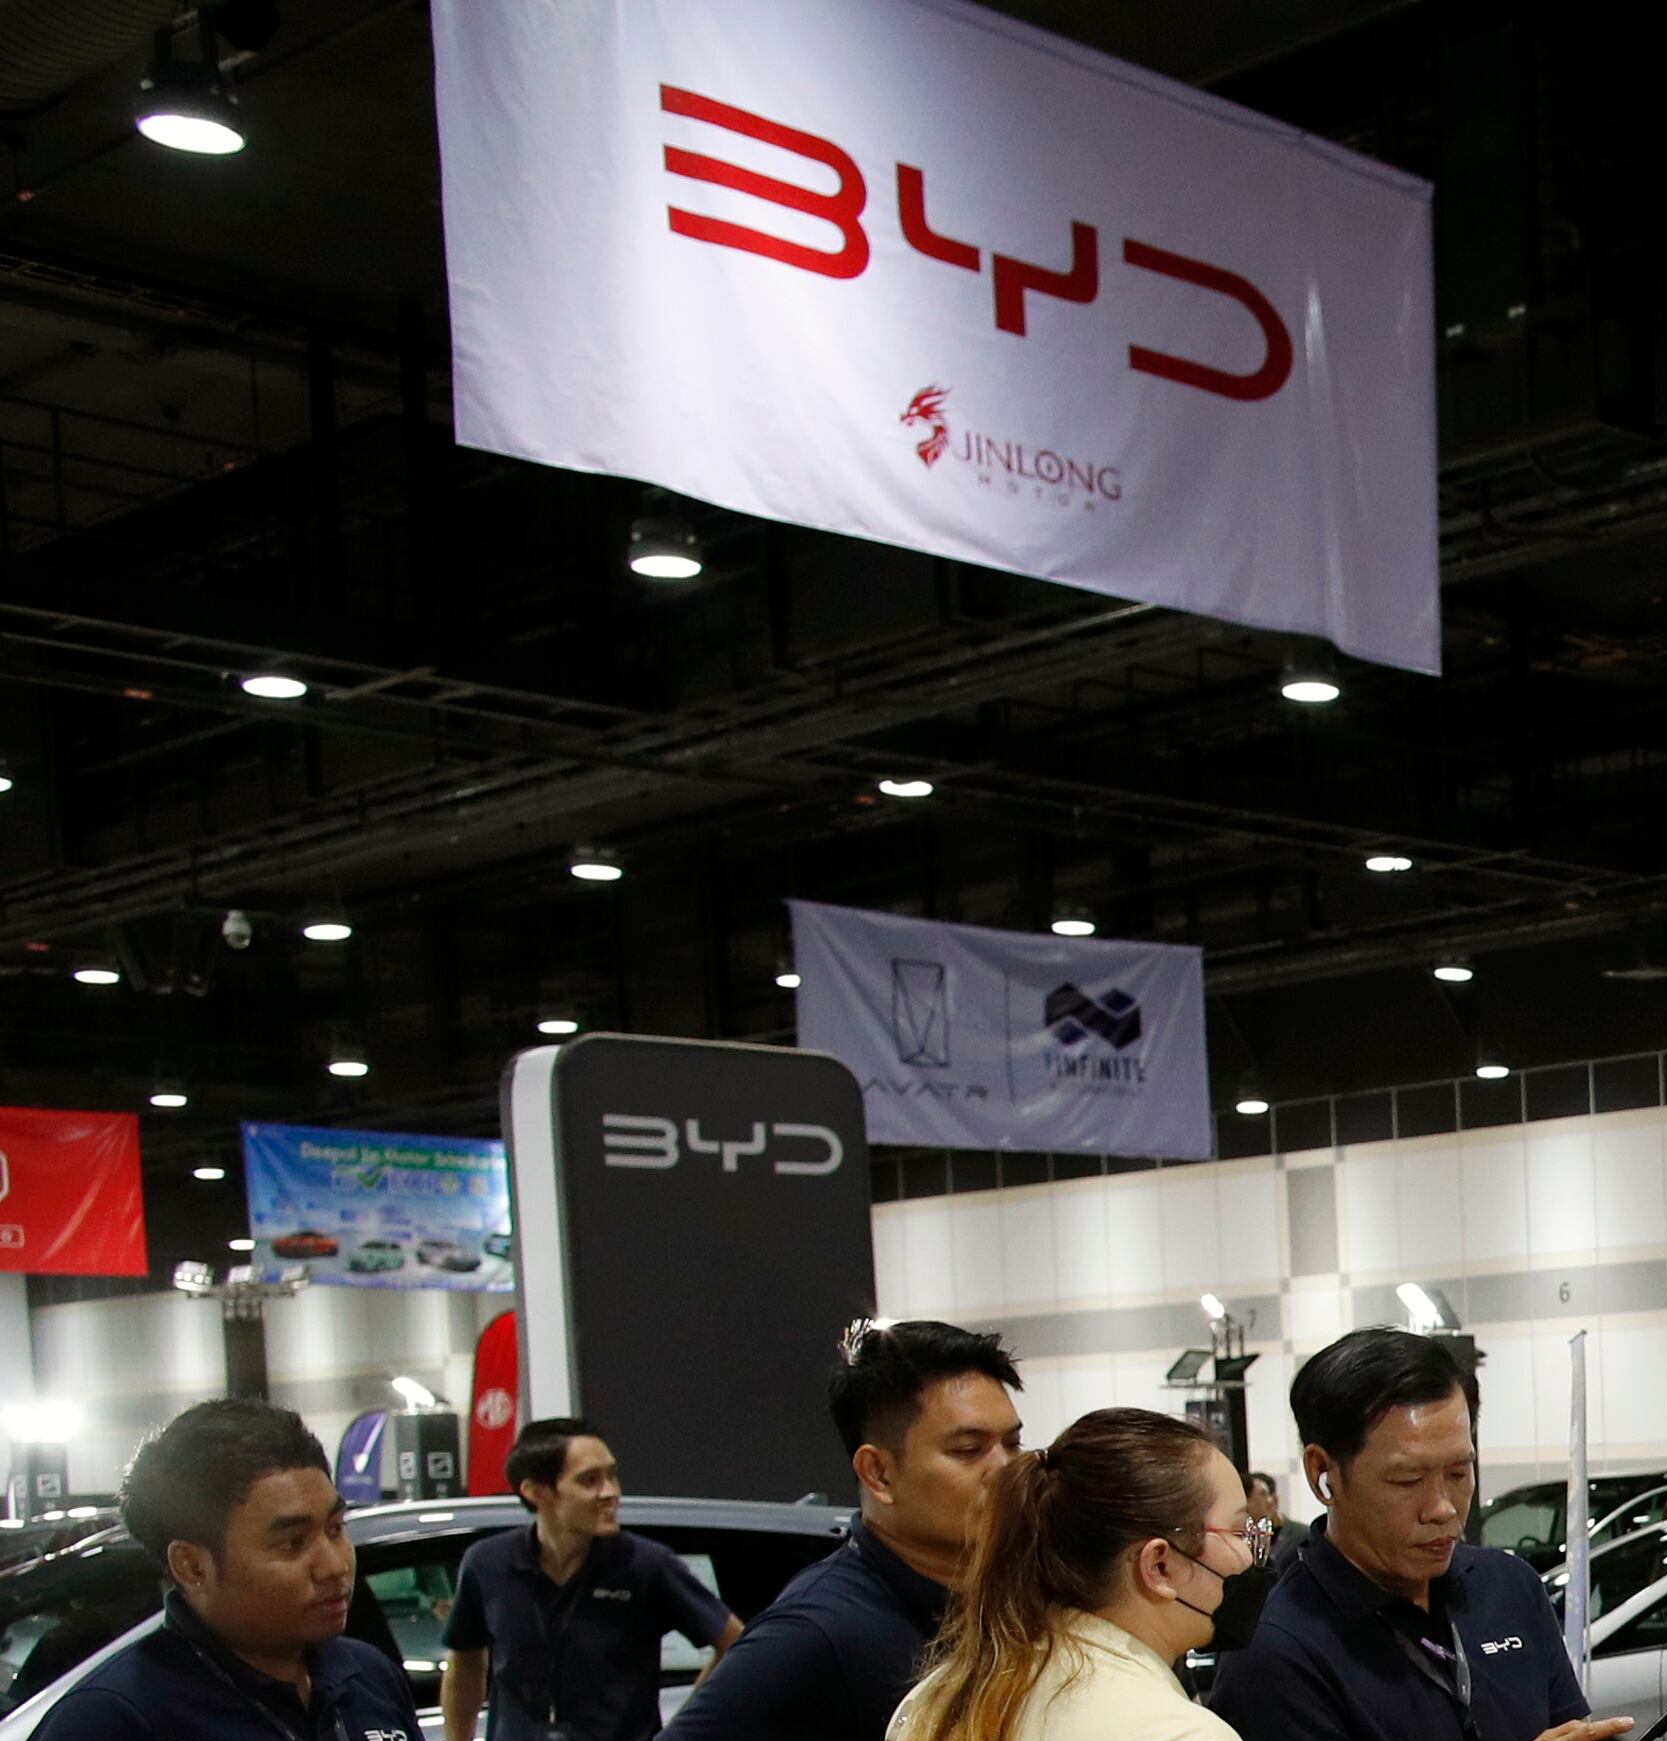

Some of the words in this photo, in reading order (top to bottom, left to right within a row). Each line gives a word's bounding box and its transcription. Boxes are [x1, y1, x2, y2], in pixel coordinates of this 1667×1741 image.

[659, 83, 1293, 402] BYD
[953, 431, 1122, 501] JINLONG
[602, 1113, 844, 1176] BYD
[1559, 1281, 1571, 1304] 6
[1480, 1636, 1523, 1655] BYD
